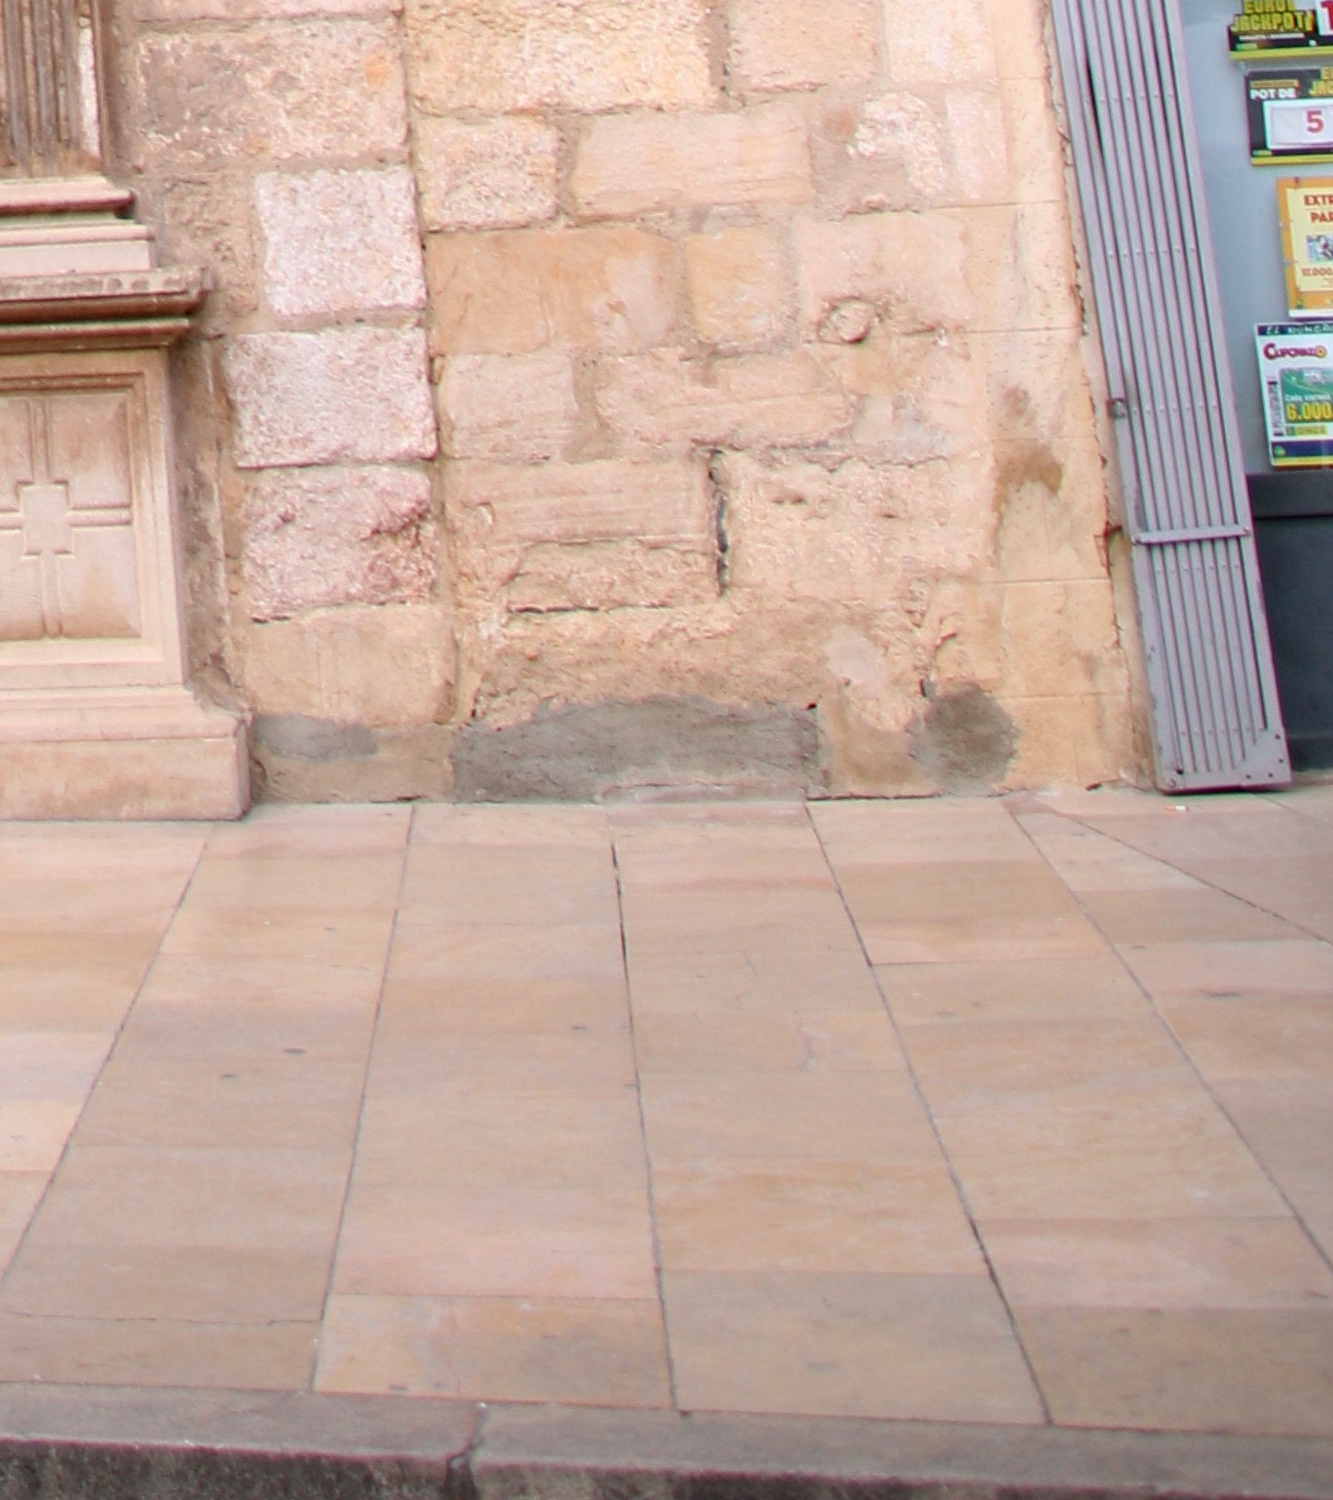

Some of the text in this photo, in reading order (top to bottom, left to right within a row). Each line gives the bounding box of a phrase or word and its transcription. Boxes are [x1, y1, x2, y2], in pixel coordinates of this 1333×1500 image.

[1231, 11, 1305, 32] JACKPOT
[1251, 87, 1297, 100] POT DE
[1306, 109, 1324, 134] 5
